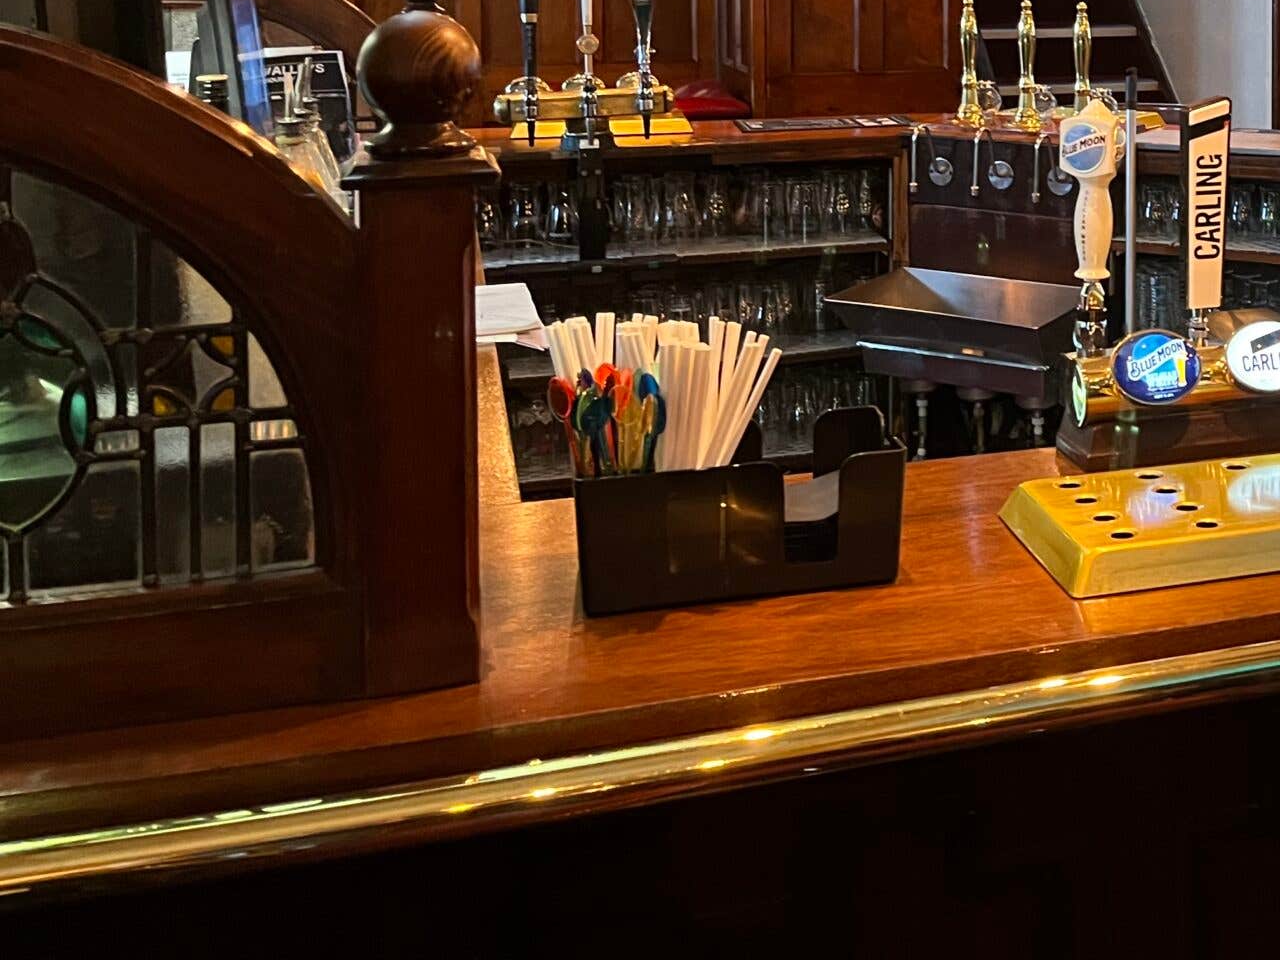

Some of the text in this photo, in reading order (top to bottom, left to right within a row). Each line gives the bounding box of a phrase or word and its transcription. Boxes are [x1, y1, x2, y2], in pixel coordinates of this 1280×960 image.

[1061, 135, 1106, 158] BLUE MOON
[1193, 153, 1223, 261] CARLING
[1130, 341, 1184, 379] BLUE MOON
